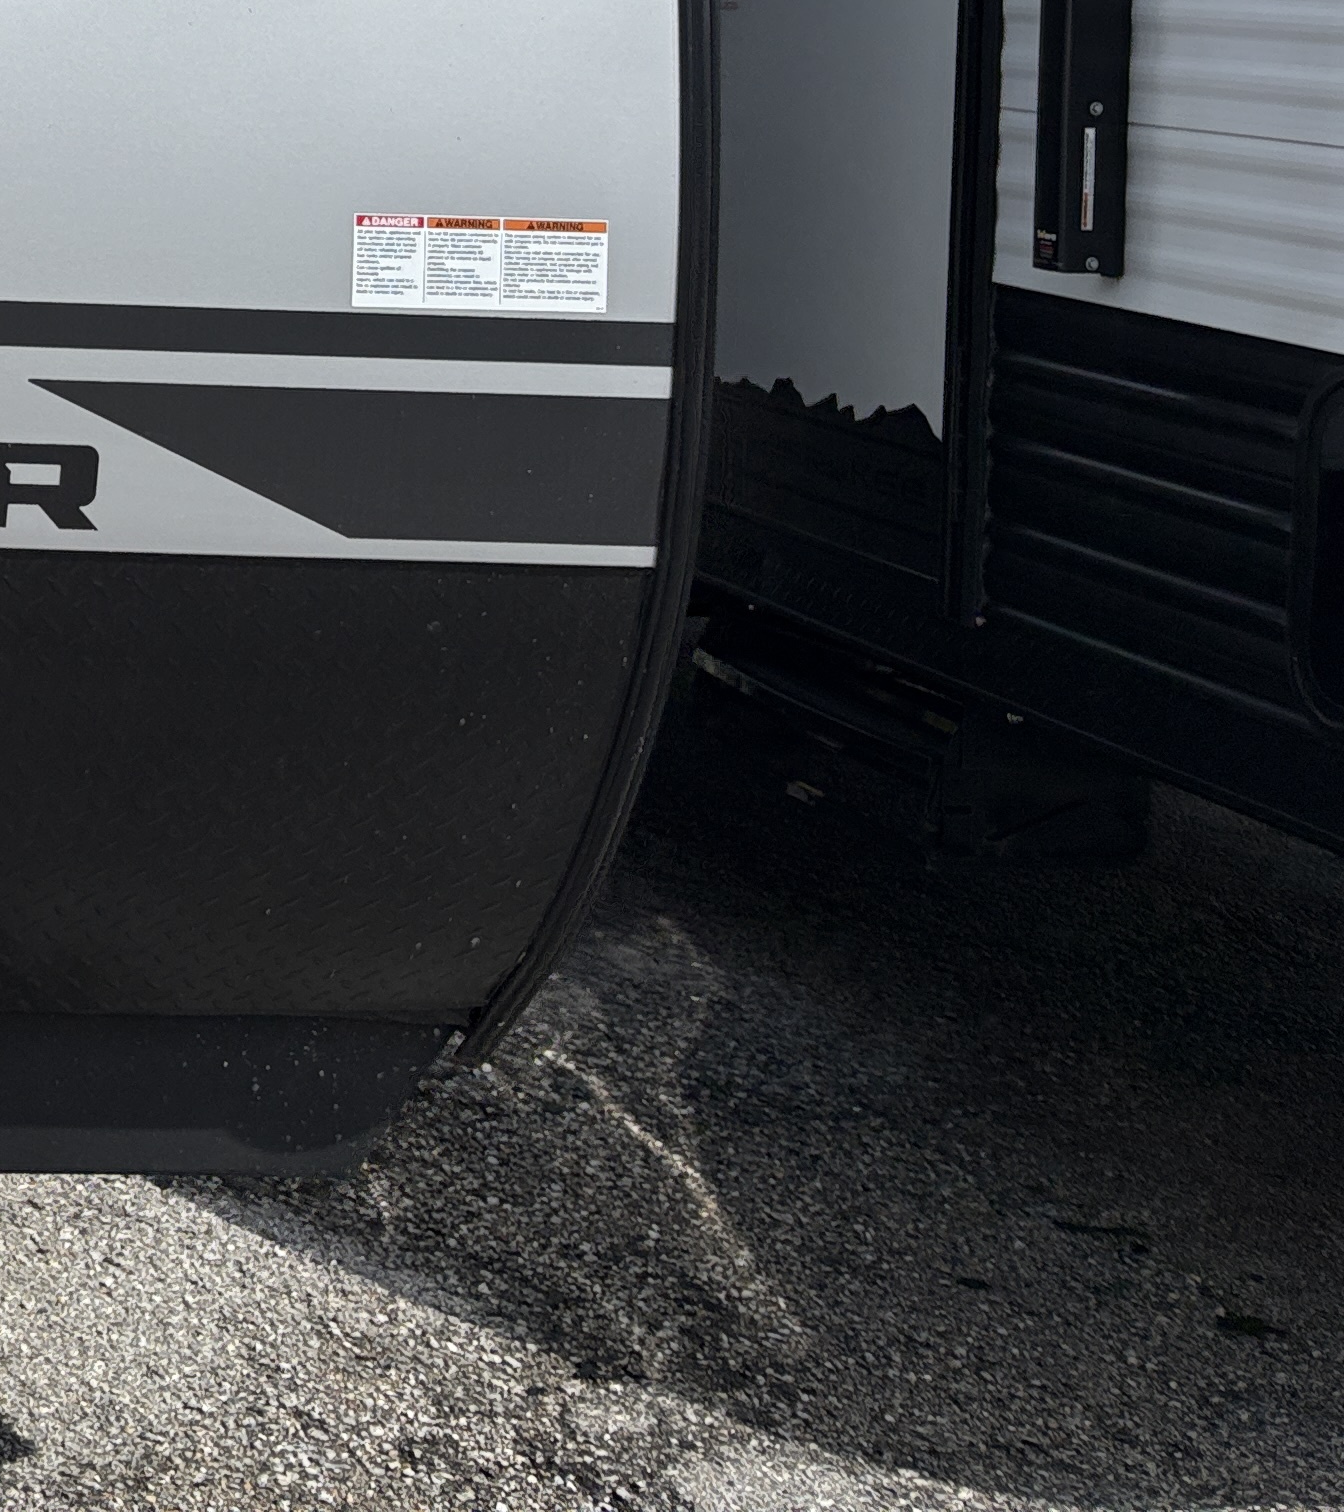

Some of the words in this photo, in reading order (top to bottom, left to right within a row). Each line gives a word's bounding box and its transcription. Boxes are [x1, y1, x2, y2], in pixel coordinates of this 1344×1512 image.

[372, 216, 419, 227] DANGER
[446, 218, 493, 229] WARNING
[536, 220, 584, 231] WARNING
